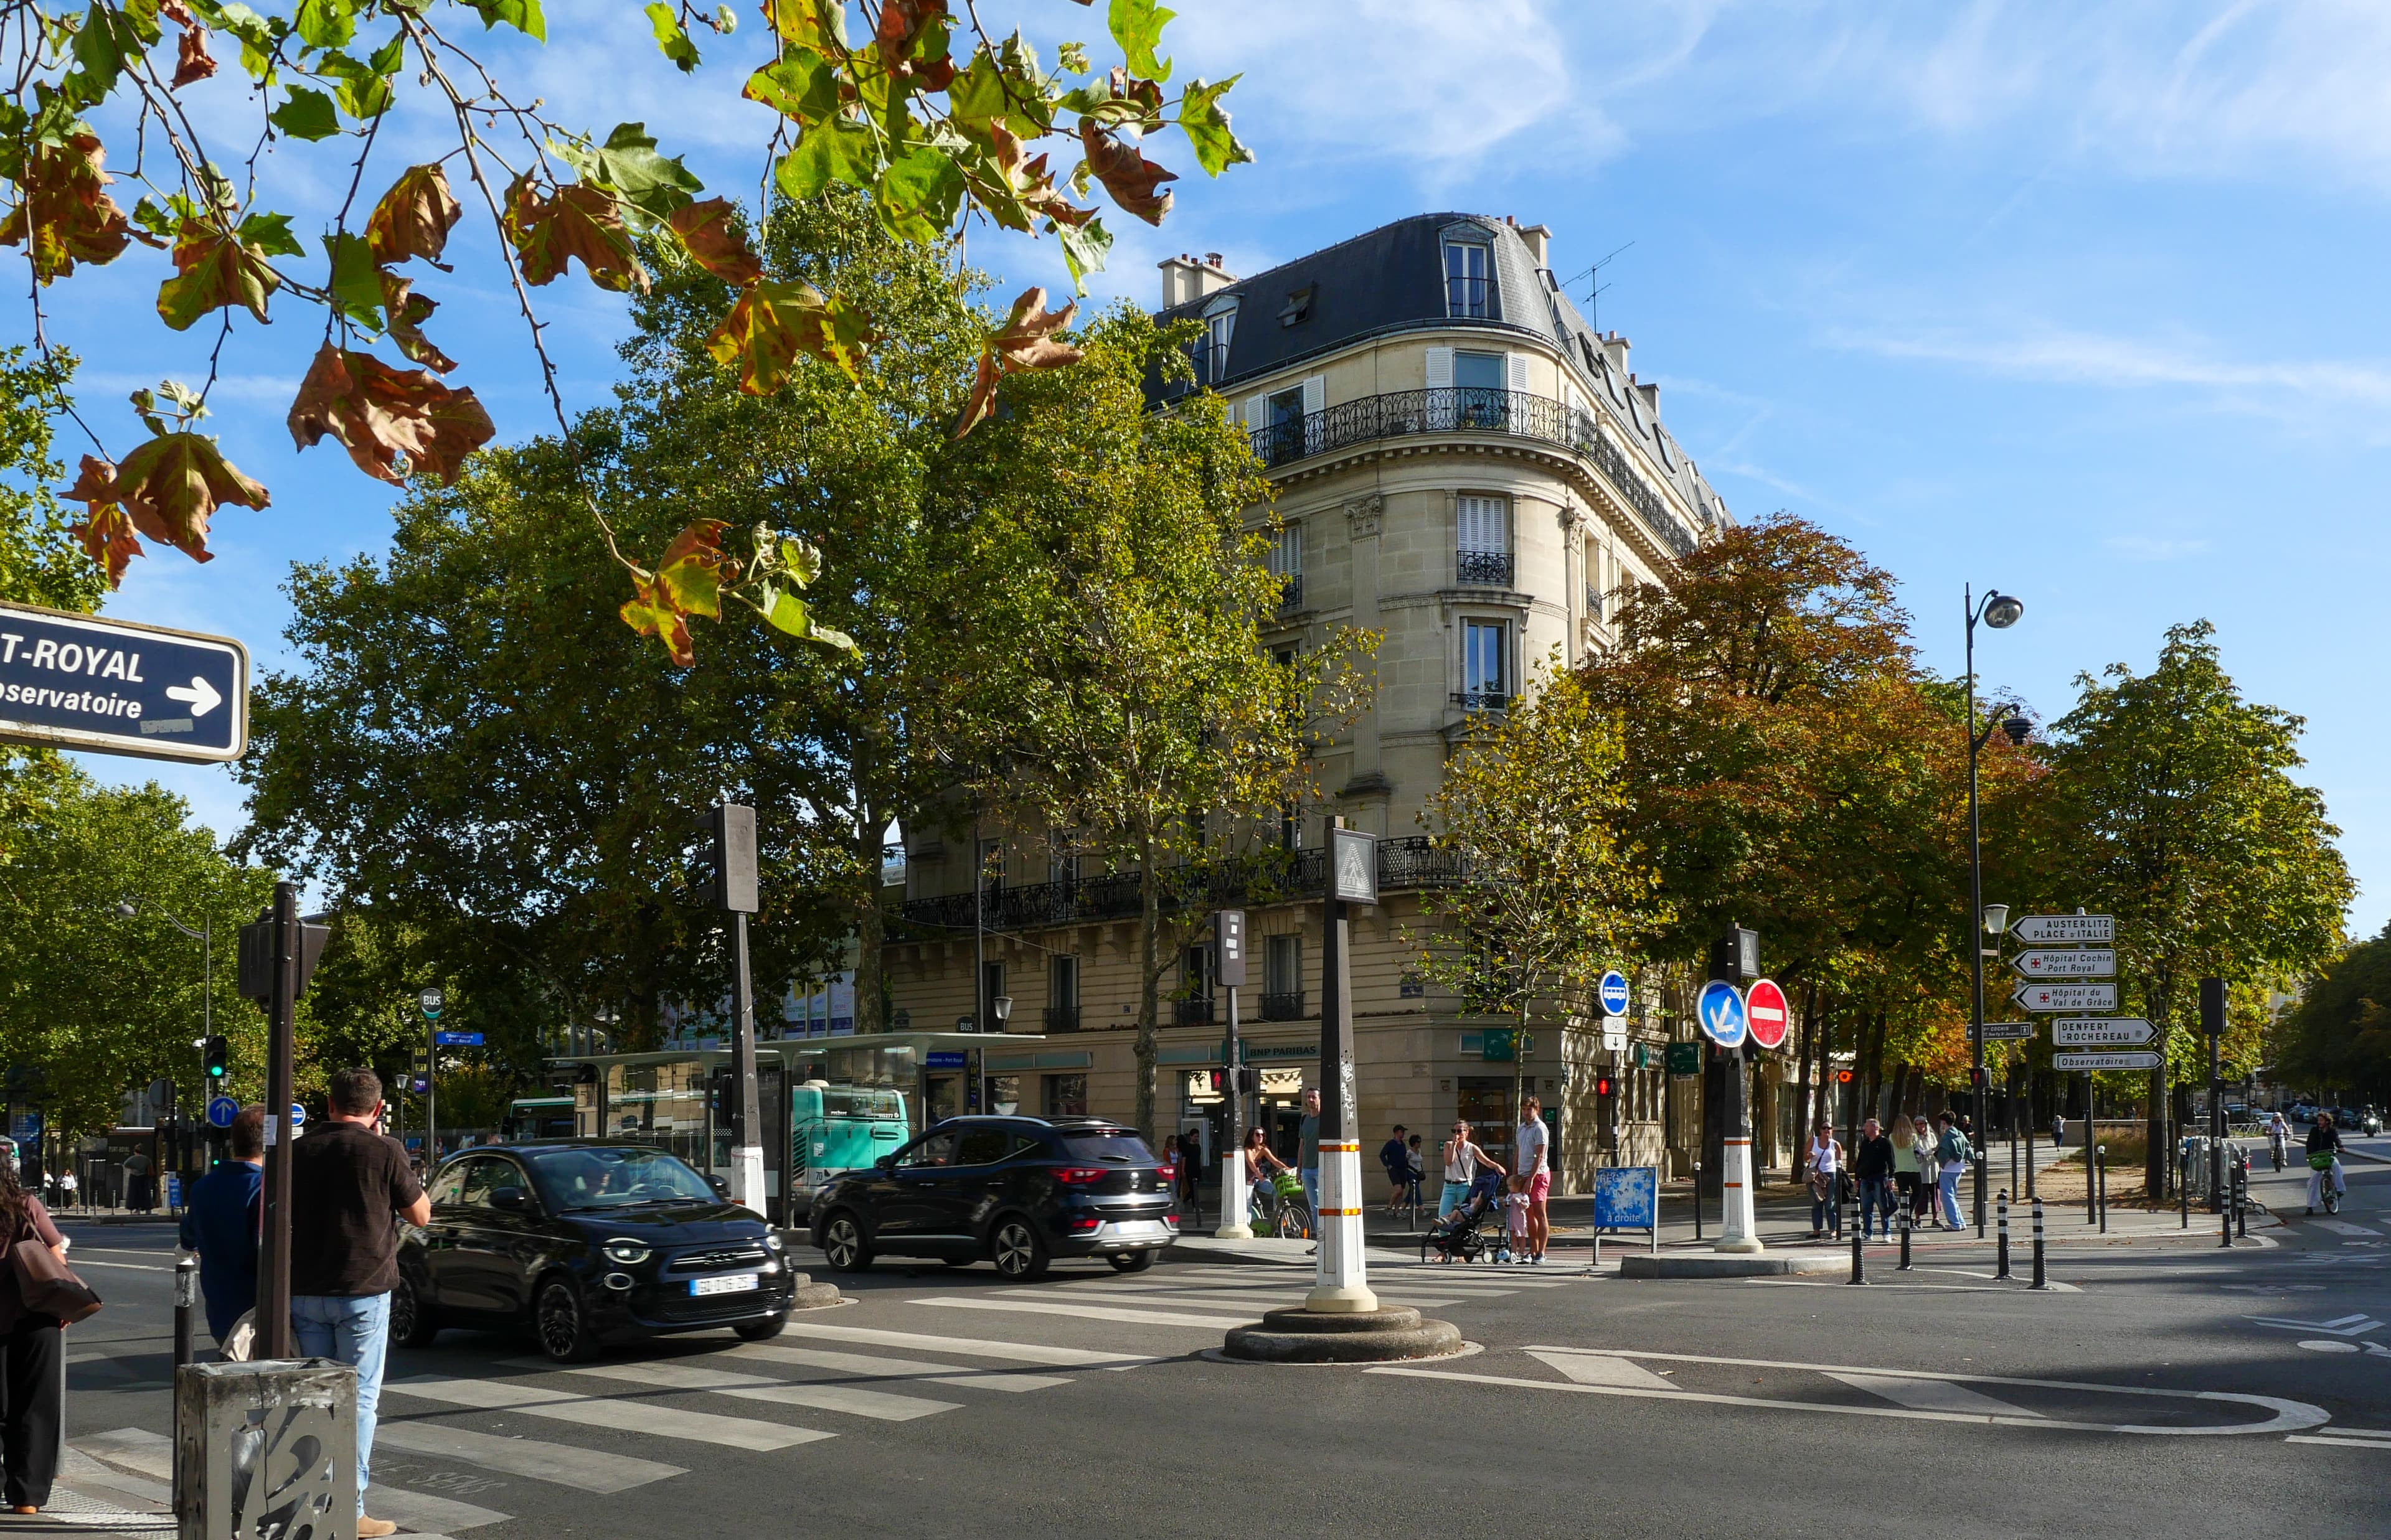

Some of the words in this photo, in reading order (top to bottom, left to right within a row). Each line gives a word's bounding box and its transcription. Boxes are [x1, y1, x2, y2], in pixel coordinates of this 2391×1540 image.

[2047, 920, 2109, 928] AUSTERLITZ
[2043, 954, 2076, 964] Hôpital
[2071, 964, 2095, 973] Royal
[2052, 988, 2085, 998] Hôpital
[423, 995, 441, 1005] BUS
[960, 1023, 973, 1031] BUS
[1250, 1048, 1271, 1056] BNP
[1273, 1046, 1316, 1056] PARIBAS
[2062, 1058, 2123, 1066] Observatoire
[1615, 1214, 1640, 1223] droite
